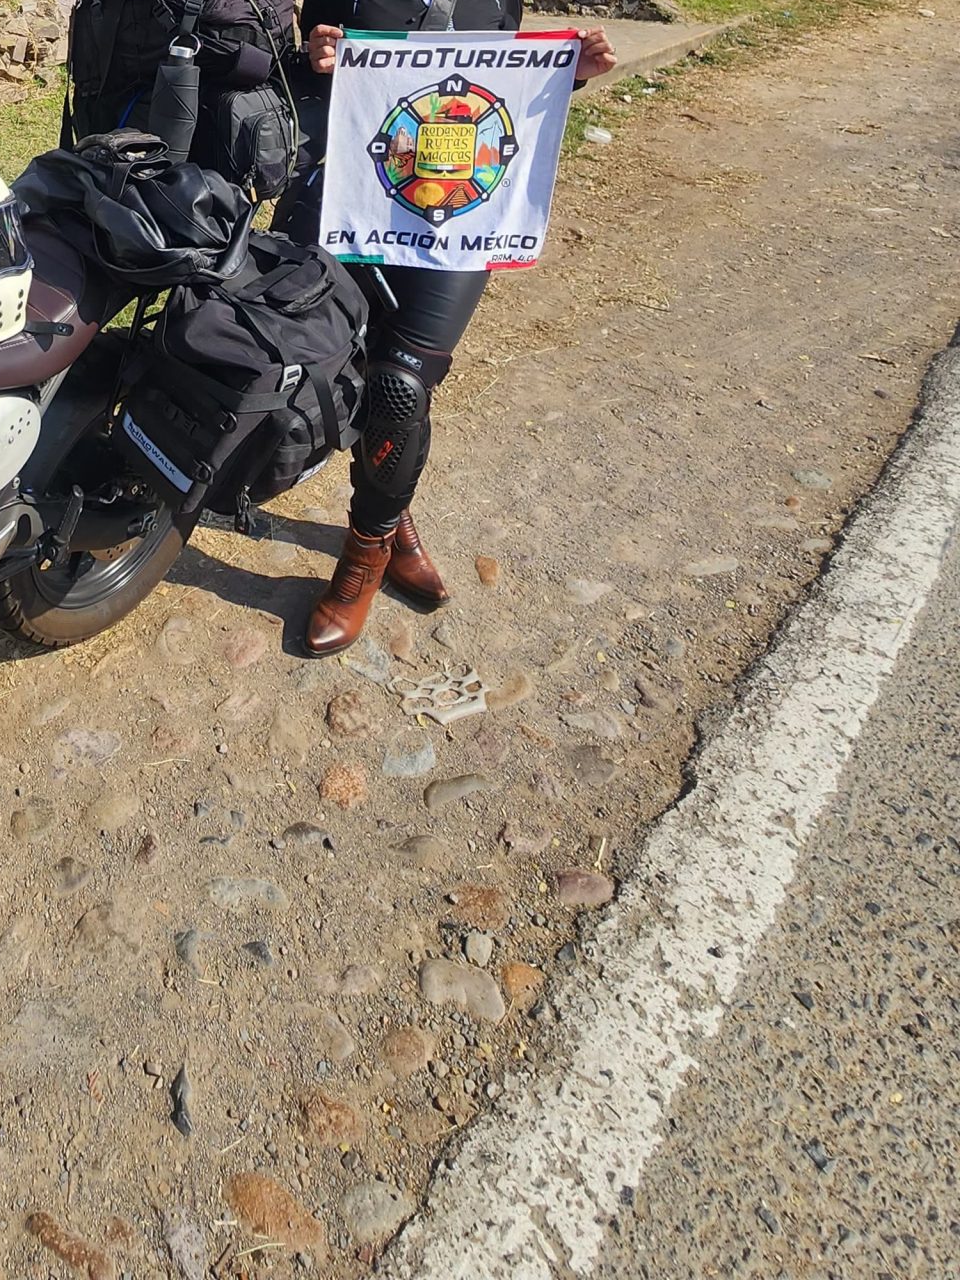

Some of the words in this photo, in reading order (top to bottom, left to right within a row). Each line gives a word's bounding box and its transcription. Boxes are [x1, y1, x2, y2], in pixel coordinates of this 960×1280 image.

[340, 47, 575, 69] MOTOTURISMO
[446, 80, 462, 92] N
[371, 142, 386, 153] O
[503, 144, 515, 155] E
[433, 209, 445, 221] S
[326, 230, 356, 245] EN
[365, 229, 449, 250] ACCIÓN
[461, 231, 538, 251] MÉXICO
[128, 422, 176, 476] RHINOWALK
[373, 440, 394, 466] LS2
